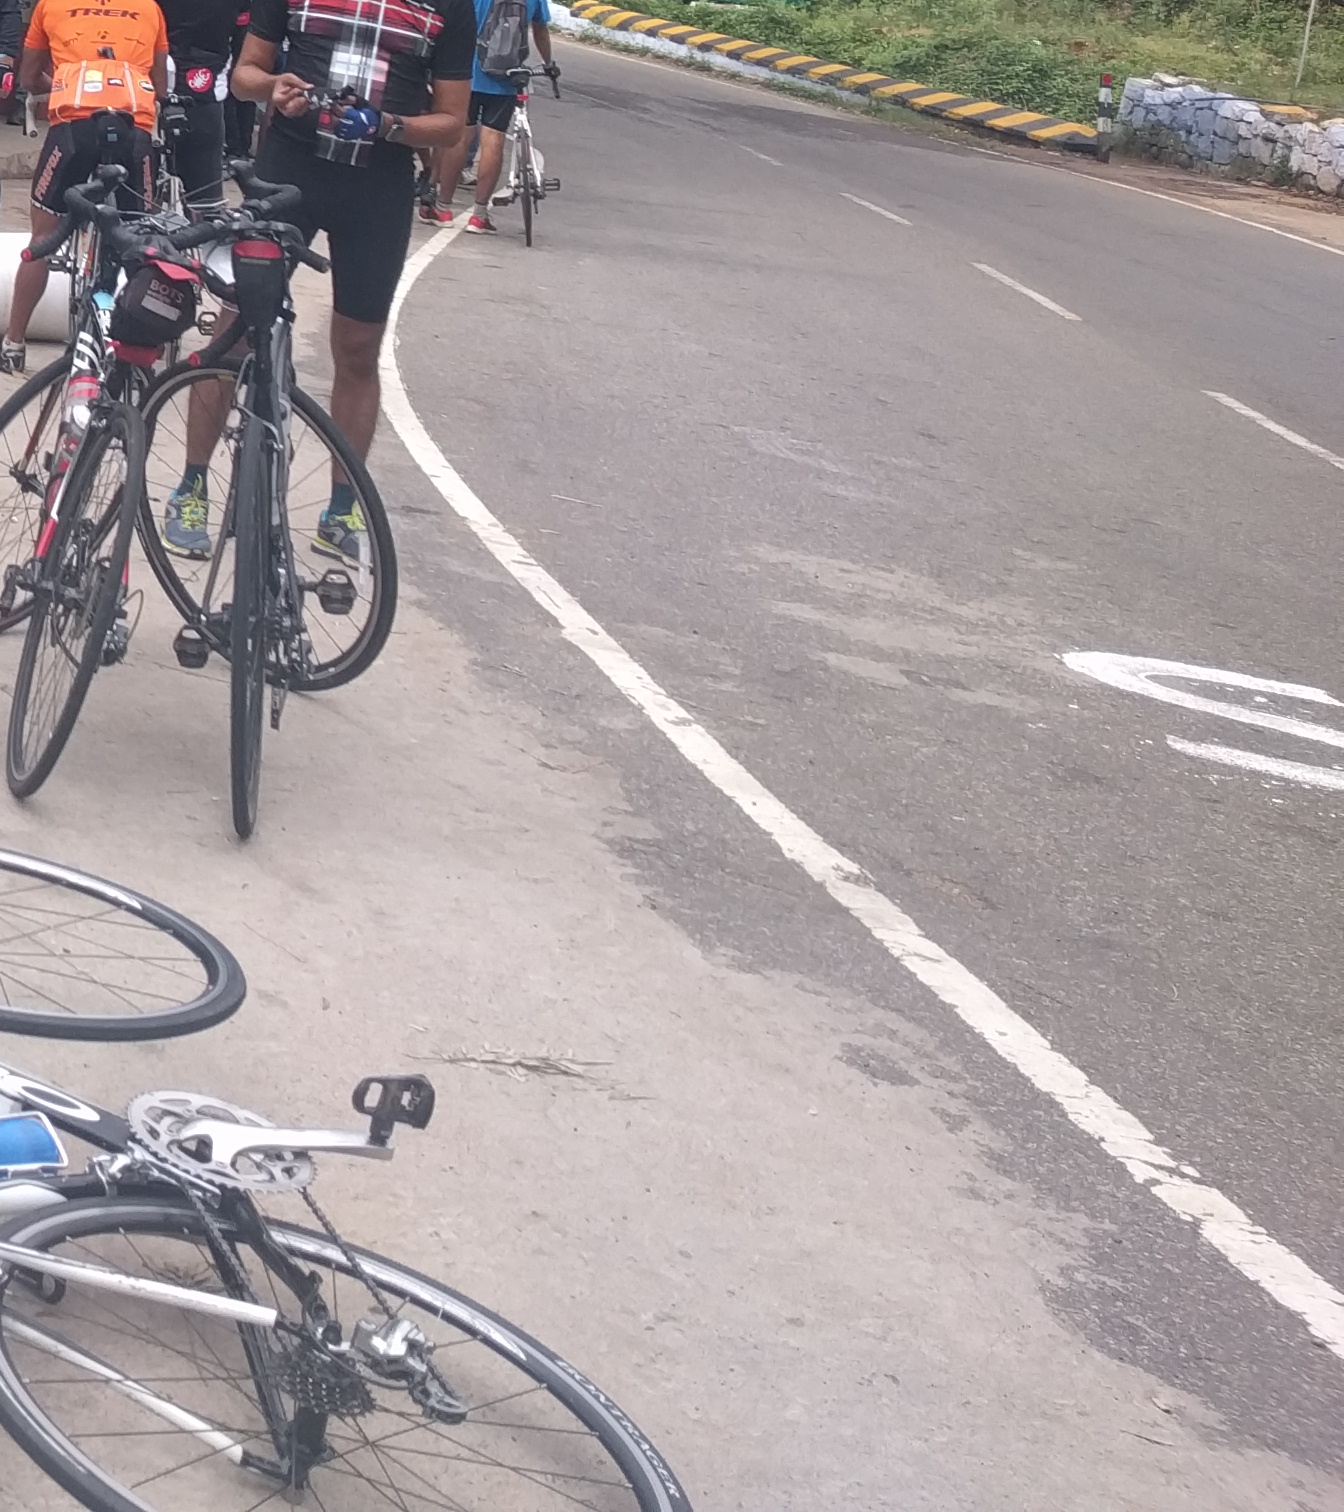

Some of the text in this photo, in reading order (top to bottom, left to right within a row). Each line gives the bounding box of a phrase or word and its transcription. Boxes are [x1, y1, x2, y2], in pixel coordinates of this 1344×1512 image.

[65, 7, 141, 21] TREK
[34, 144, 63, 202] FIREFOX
[553, 1359, 681, 1499] BONTRAGER
